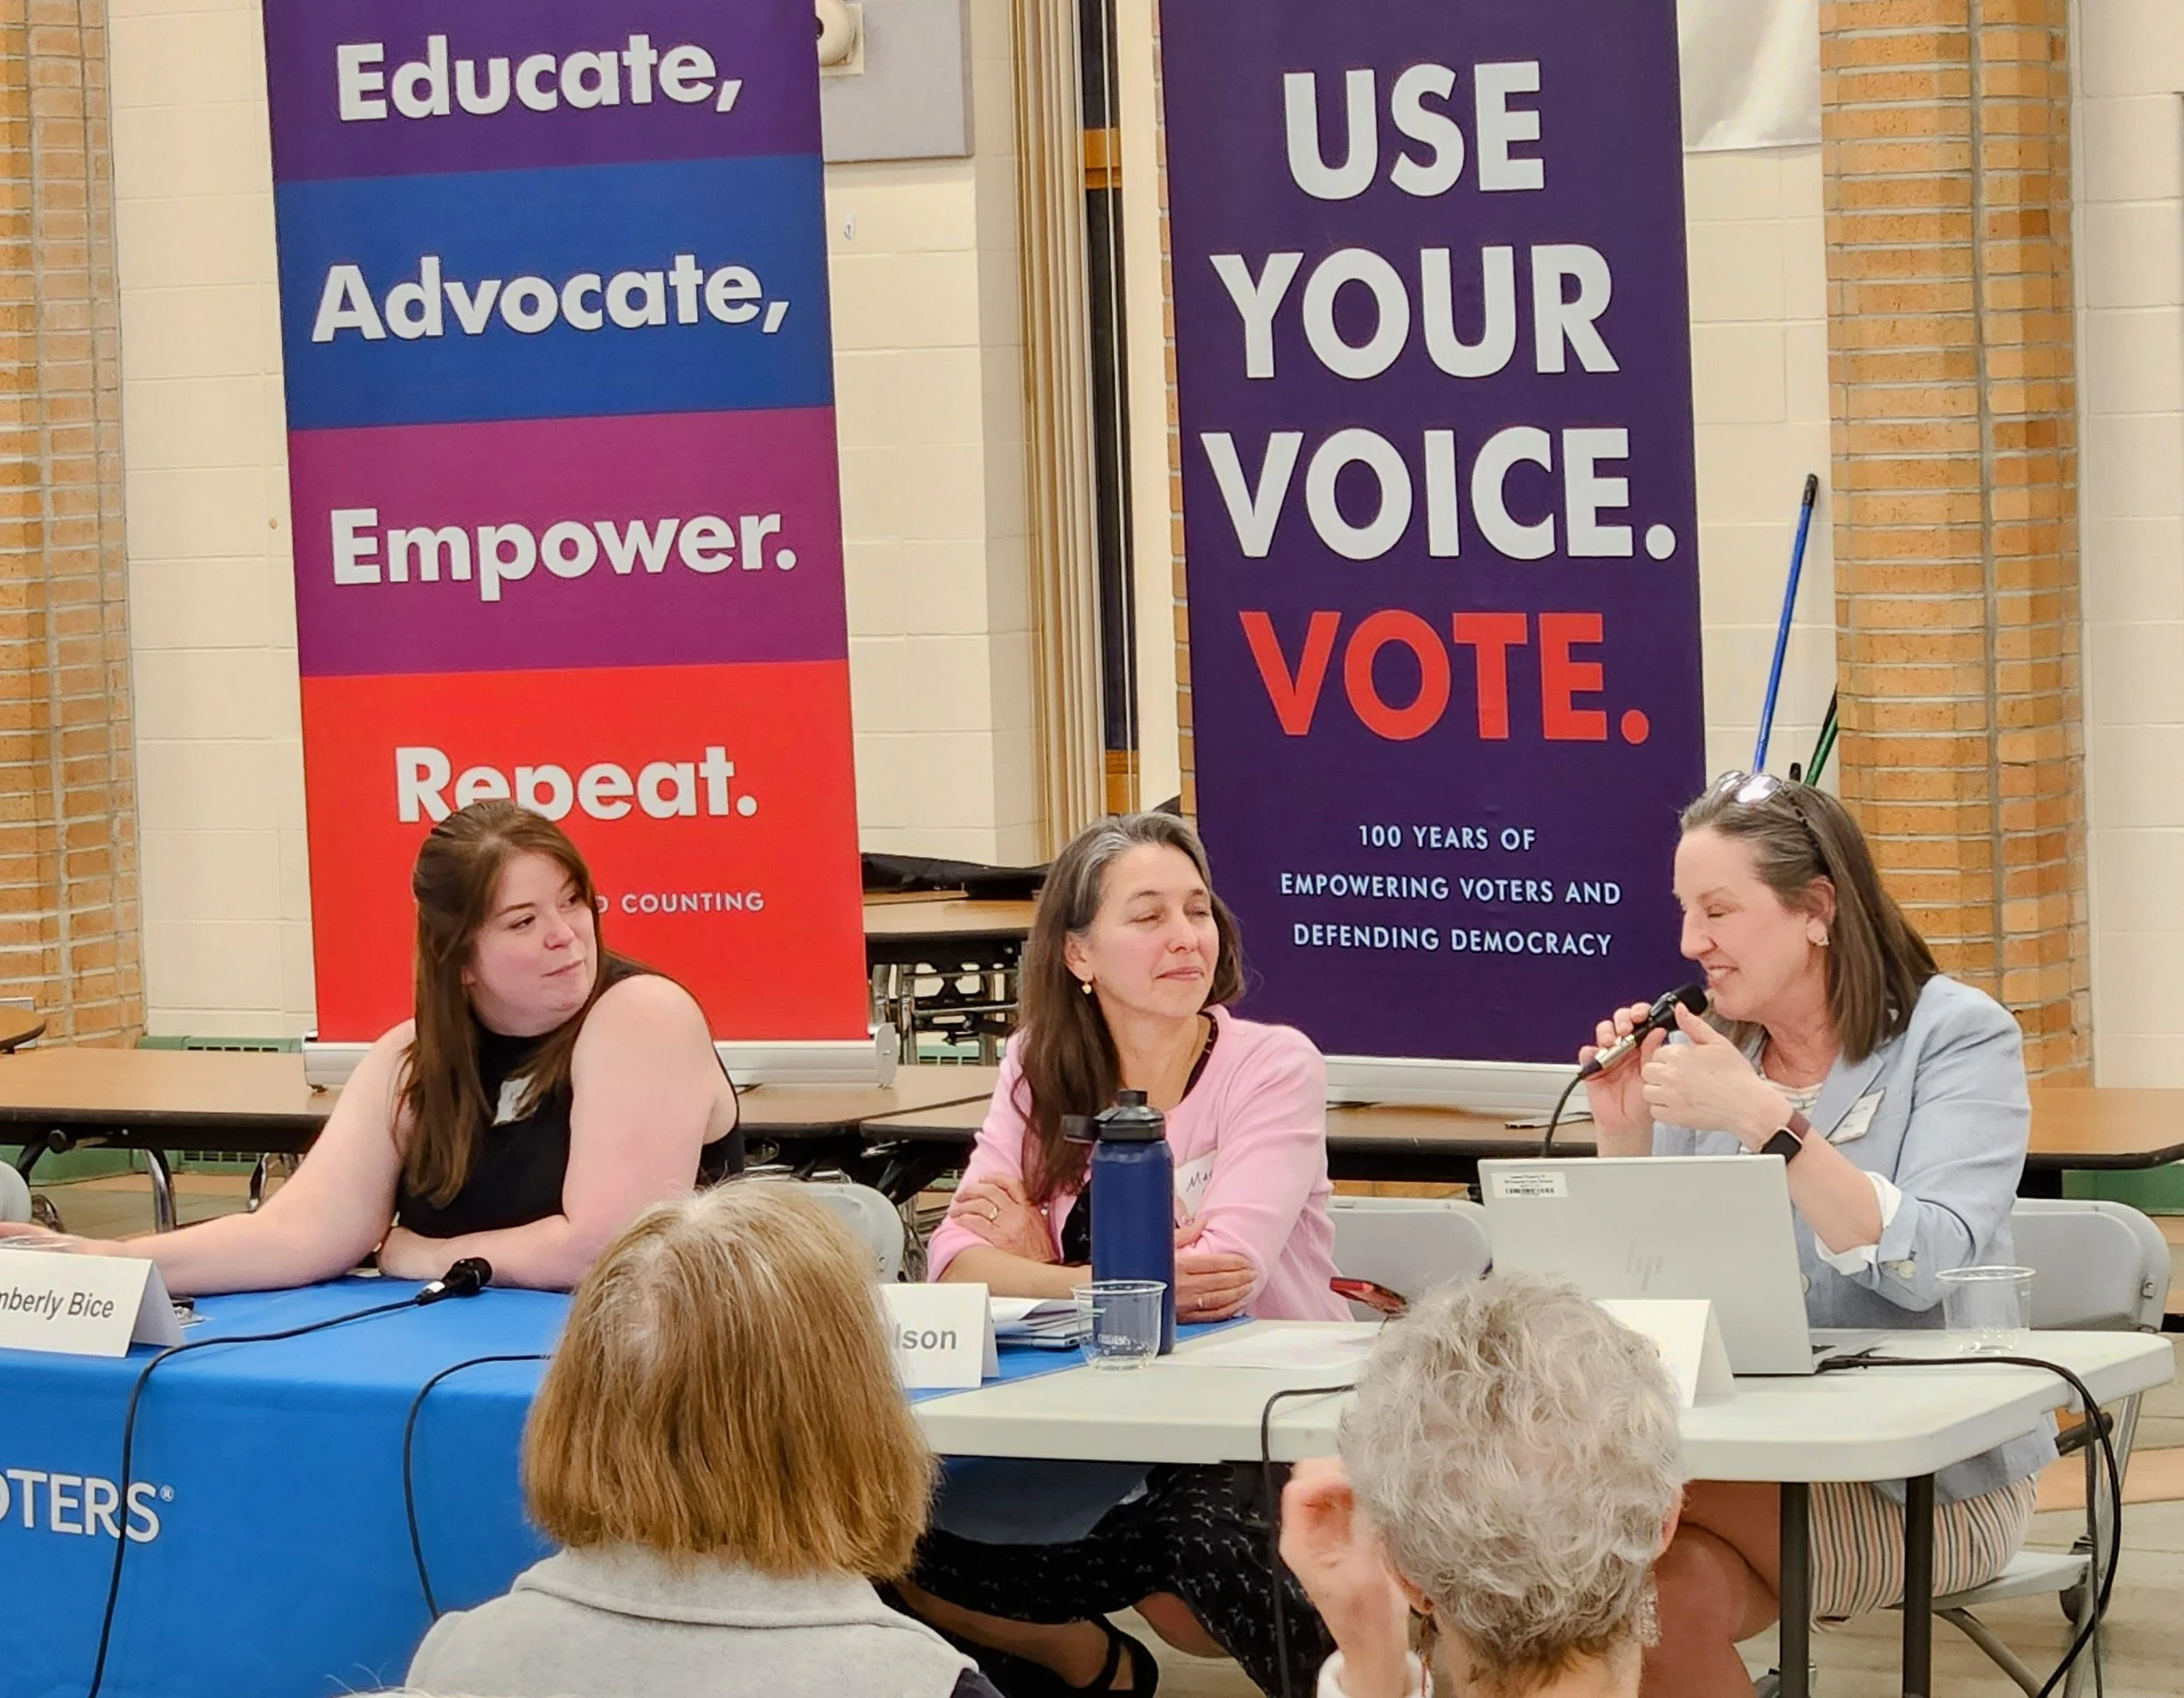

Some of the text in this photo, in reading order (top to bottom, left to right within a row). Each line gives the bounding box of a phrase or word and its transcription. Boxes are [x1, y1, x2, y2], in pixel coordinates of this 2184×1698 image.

[337, 34, 743, 121] Educate,
[1283, 59, 1545, 200] USE
[311, 253, 790, 342] Advocate,
[1209, 244, 1621, 379] YOUR
[1199, 425, 1676, 561] VOICE.
[330, 507, 798, 602] Empower.
[1239, 609, 1650, 744] VOTE.
[396, 746, 758, 822] Repeat.
[1358, 825, 1536, 851] 100 YEARS OF
[621, 892, 765, 914] COUNTING
[1281, 873, 1621, 904] EMPOWERING VOTERS AND
[1294, 923, 1613, 956] DEFENDING DEMOCRACY
[67, 1293, 114, 1317] Bice
[895, 1323, 957, 1349] lson
